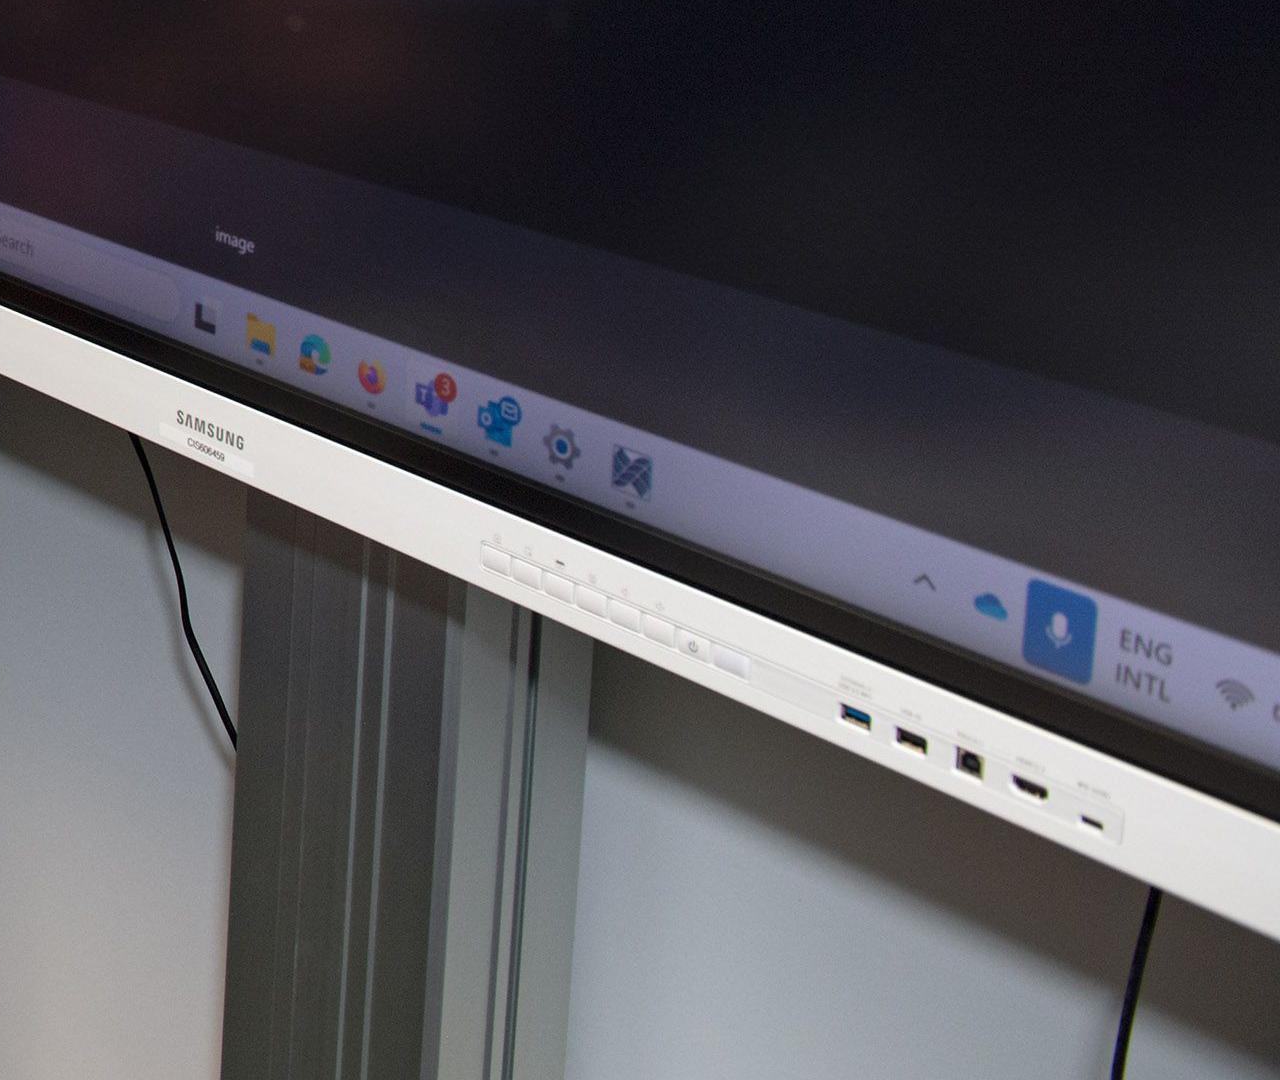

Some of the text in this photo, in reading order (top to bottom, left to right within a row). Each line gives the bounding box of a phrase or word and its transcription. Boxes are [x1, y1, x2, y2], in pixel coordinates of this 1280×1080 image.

[215, 225, 255, 255] image
[176, 409, 244, 451] SAMSUNG
[1120, 628, 1173, 666] ENG
[1115, 662, 1170, 704] INTL
